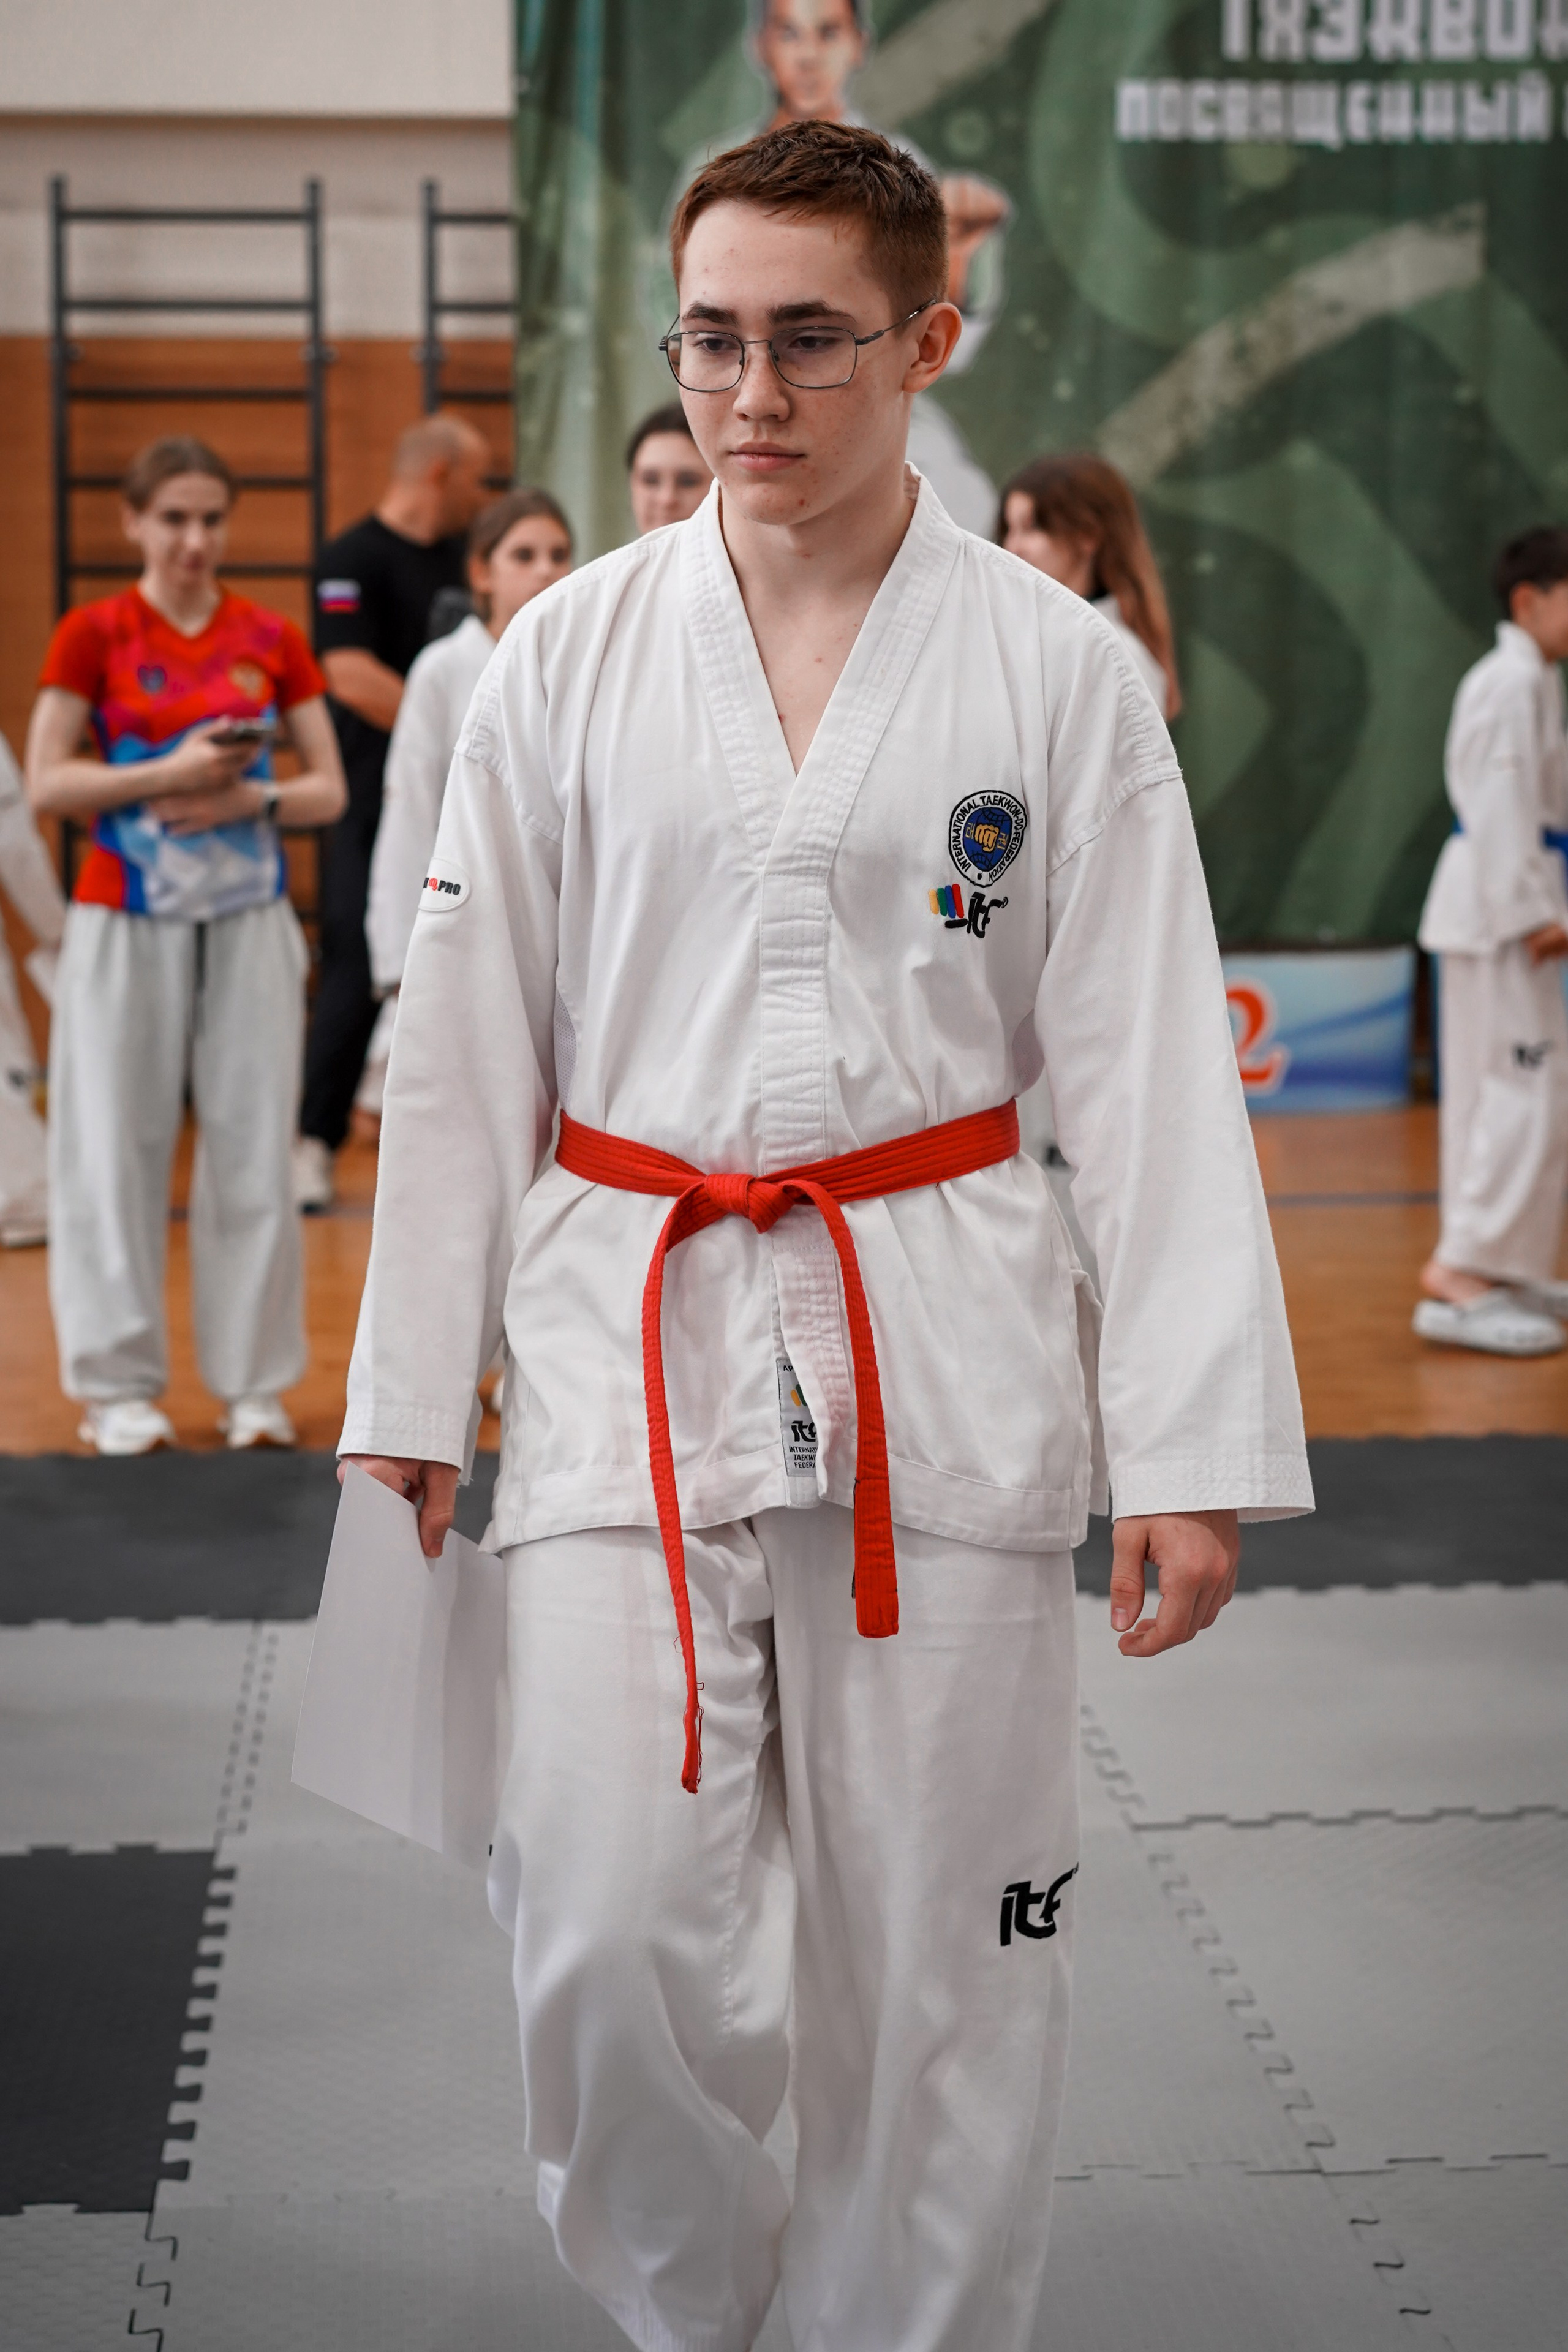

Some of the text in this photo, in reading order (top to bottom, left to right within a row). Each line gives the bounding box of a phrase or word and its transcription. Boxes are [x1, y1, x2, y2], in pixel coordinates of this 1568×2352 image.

[1117, 69, 1552, 151] ПОСВЯЩЕННЫЙ
[952, 799, 979, 872] INTERNATIONAL
[989, 831, 1021, 881] FEDERATION
[437, 880, 461, 895] PRO
